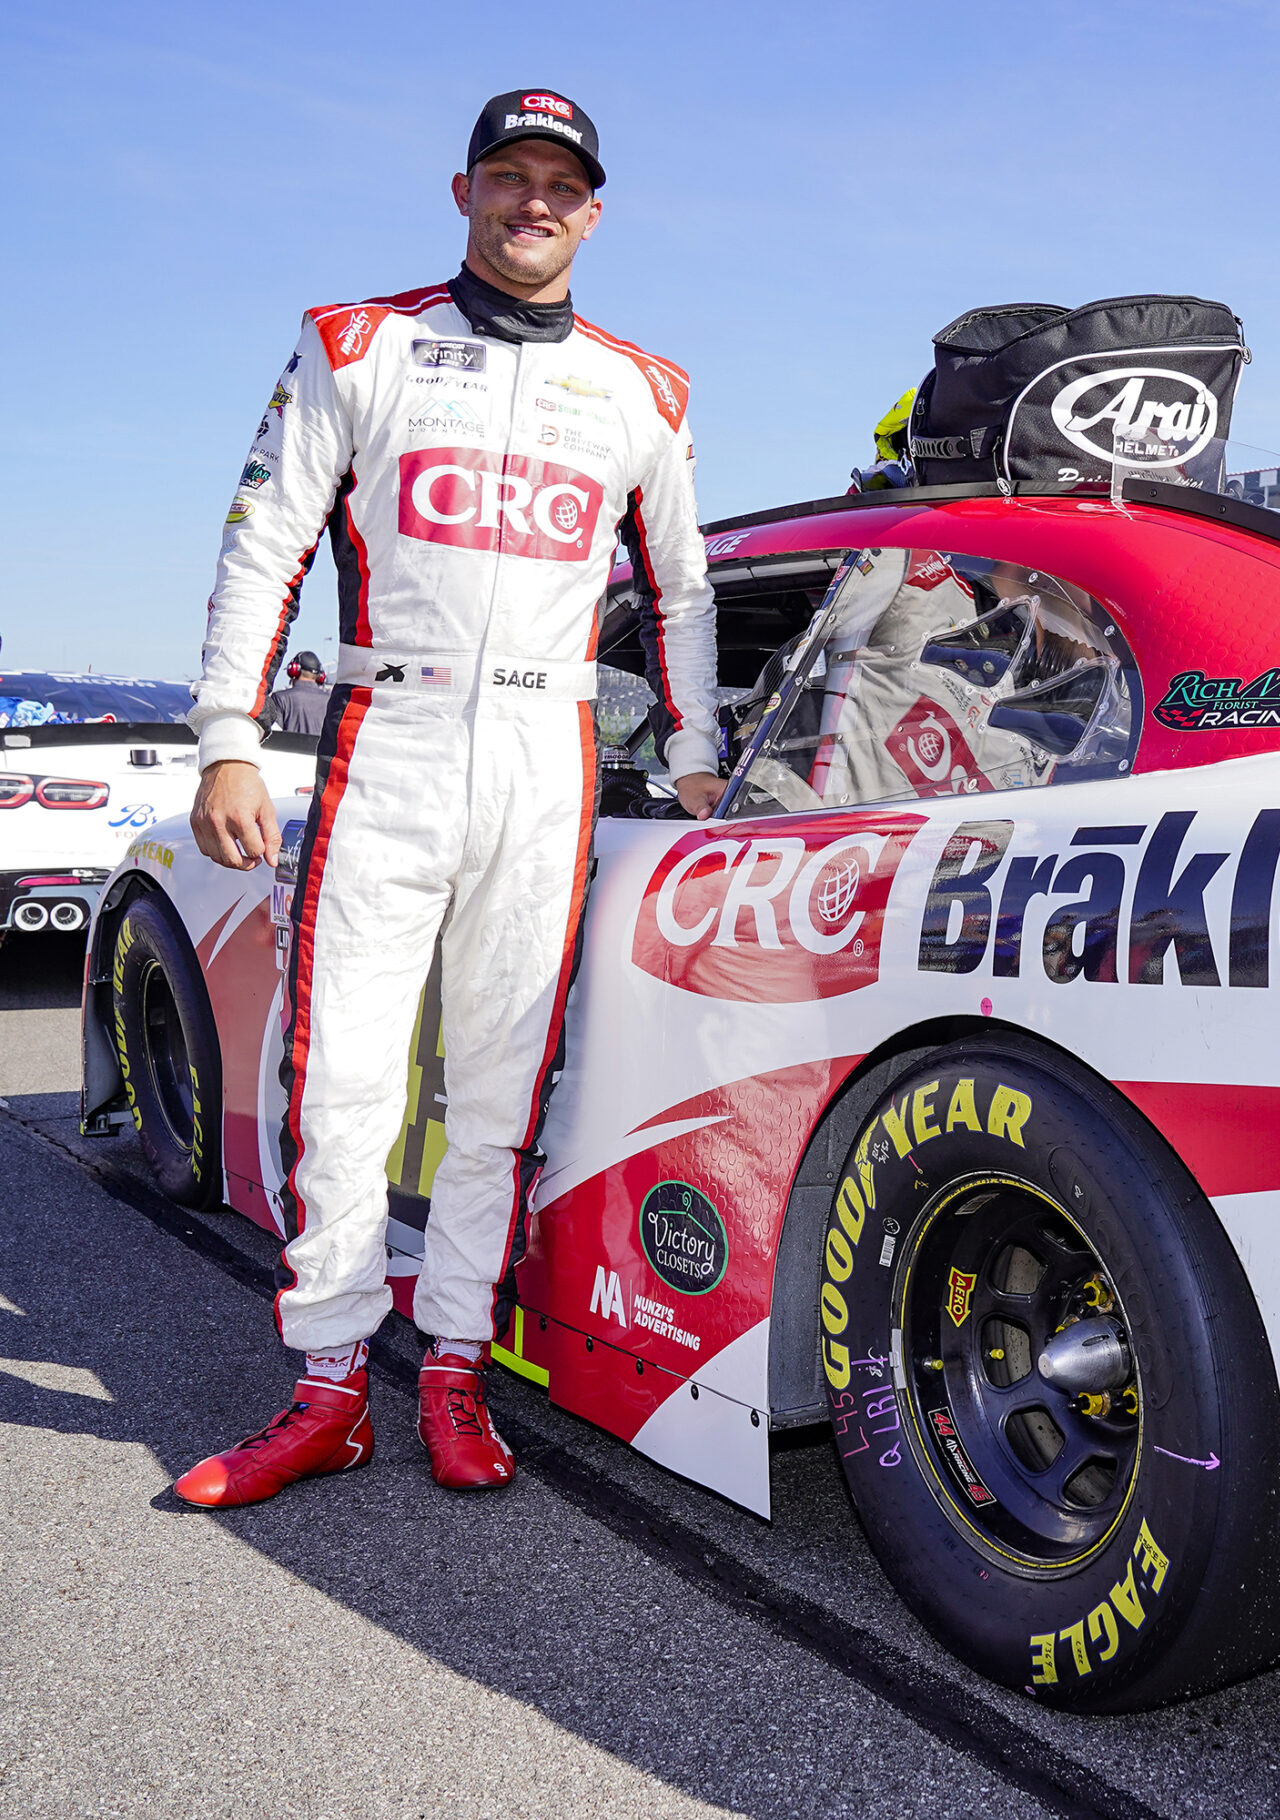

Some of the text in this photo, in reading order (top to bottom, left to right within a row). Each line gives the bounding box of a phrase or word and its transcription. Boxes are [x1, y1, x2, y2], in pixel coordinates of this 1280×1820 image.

[523, 96, 570, 117] CRC
[340, 310, 369, 356] IMPACT
[423, 349, 474, 366] xfinity
[405, 374, 488, 393] GOODYEAR
[1064, 377, 1208, 440] Arai
[408, 416, 485, 434] MONTAGE
[408, 427, 485, 438] MOUNTAIN
[564, 428, 582, 437] THE
[563, 442, 607, 460] COMPANY
[564, 435, 611, 454] DRIVEWAY
[1115, 440, 1176, 456] HELMET
[411, 464, 590, 544] CRC
[492, 668, 548, 690] SAGE
[1212, 701, 1259, 711] FLORIST
[655, 832, 892, 955] CRC
[647, 1211, 715, 1276] Victory
[820, 1076, 1033, 1391] GOODYEAR
[588, 1264, 628, 1329] NA
[952, 1275, 967, 1316] AERO
[633, 1293, 675, 1323] NUNZI'S
[633, 1312, 701, 1352] ADVERTISING
[934, 1412, 956, 1436] 44
[952, 1452, 977, 1484] RACING
[968, 1484, 992, 1502] 45
[1029, 1515, 1172, 1685] EAGLE
